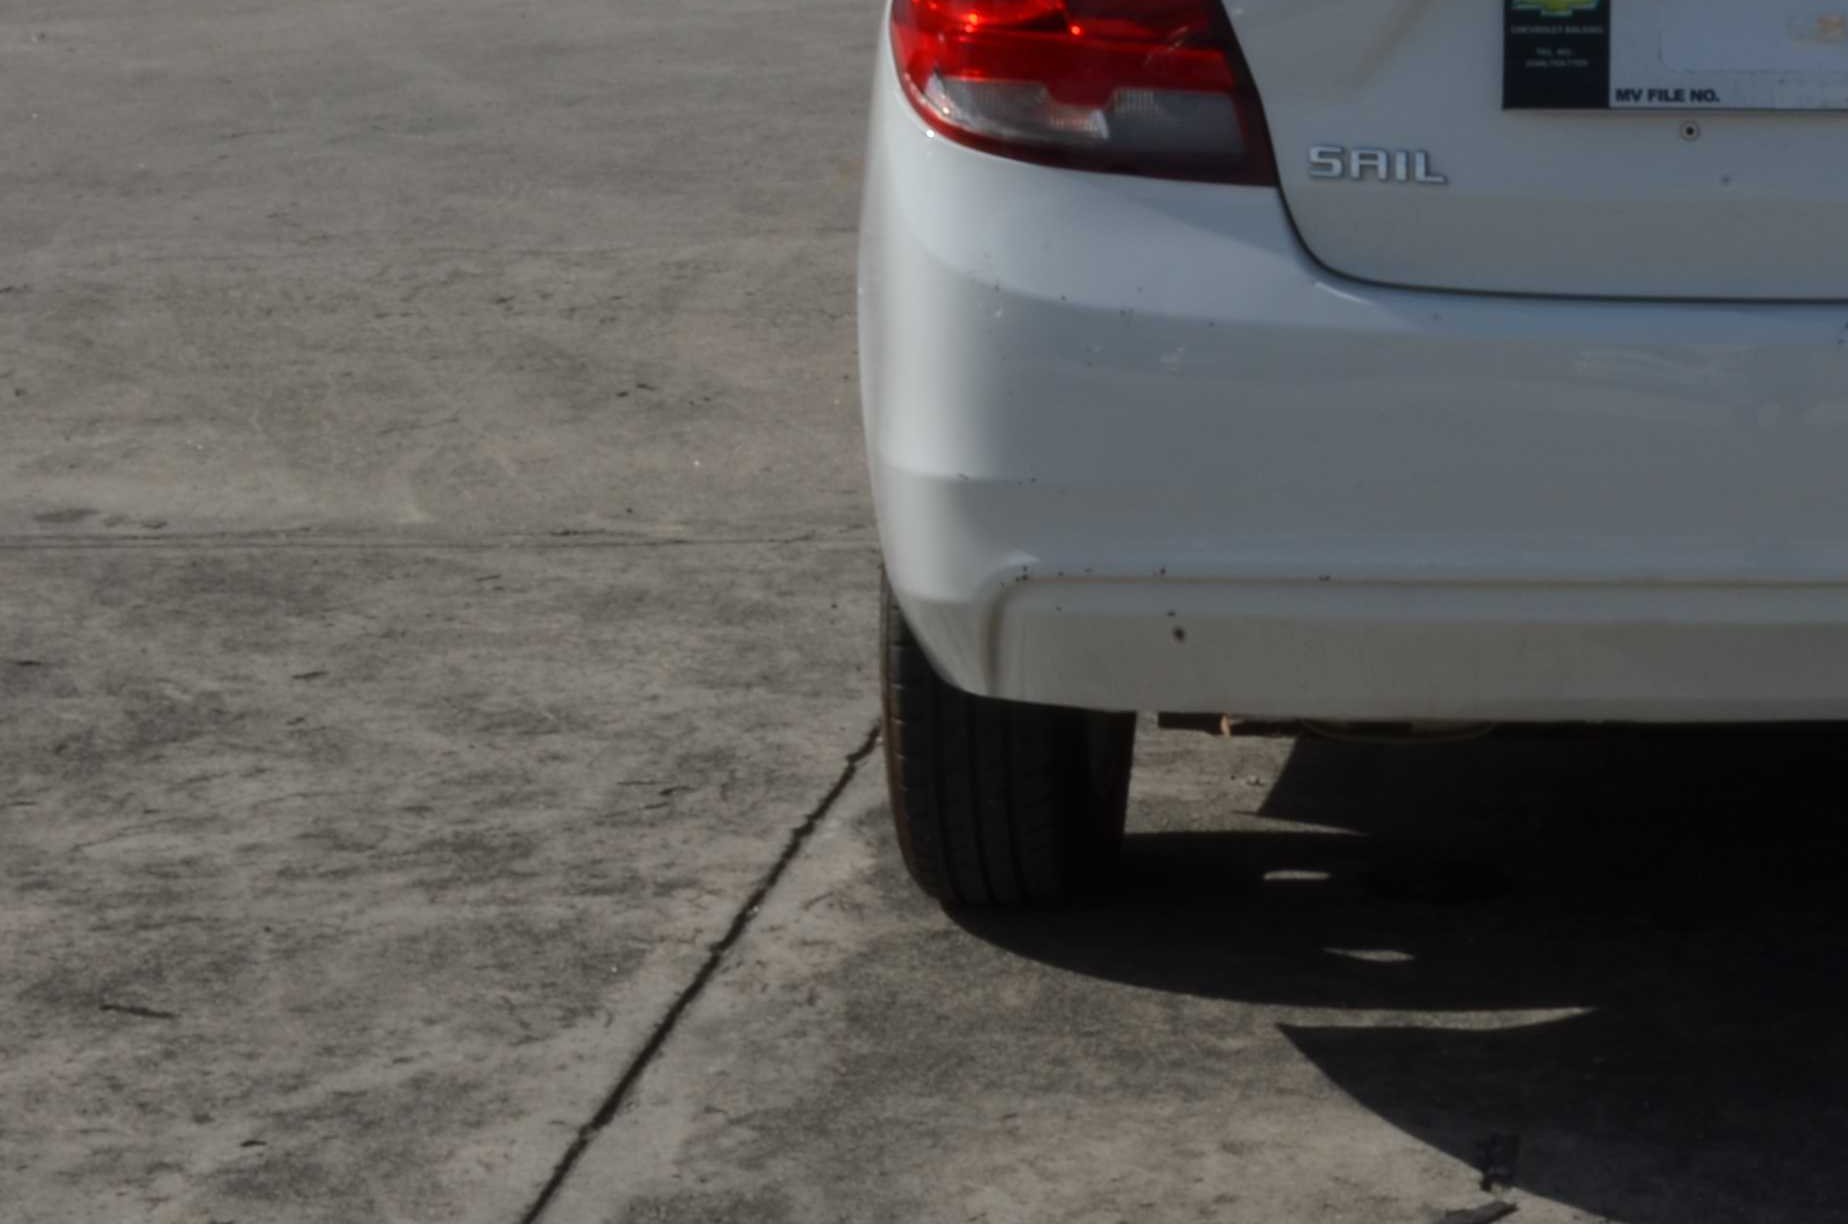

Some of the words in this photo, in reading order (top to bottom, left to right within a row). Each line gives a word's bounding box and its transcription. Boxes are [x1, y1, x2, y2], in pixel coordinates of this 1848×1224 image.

[1615, 88, 1642, 102] MV
[1647, 88, 1685, 102] FILE
[1690, 88, 1720, 103] NO.
[1308, 145, 1448, 184] SAIL
